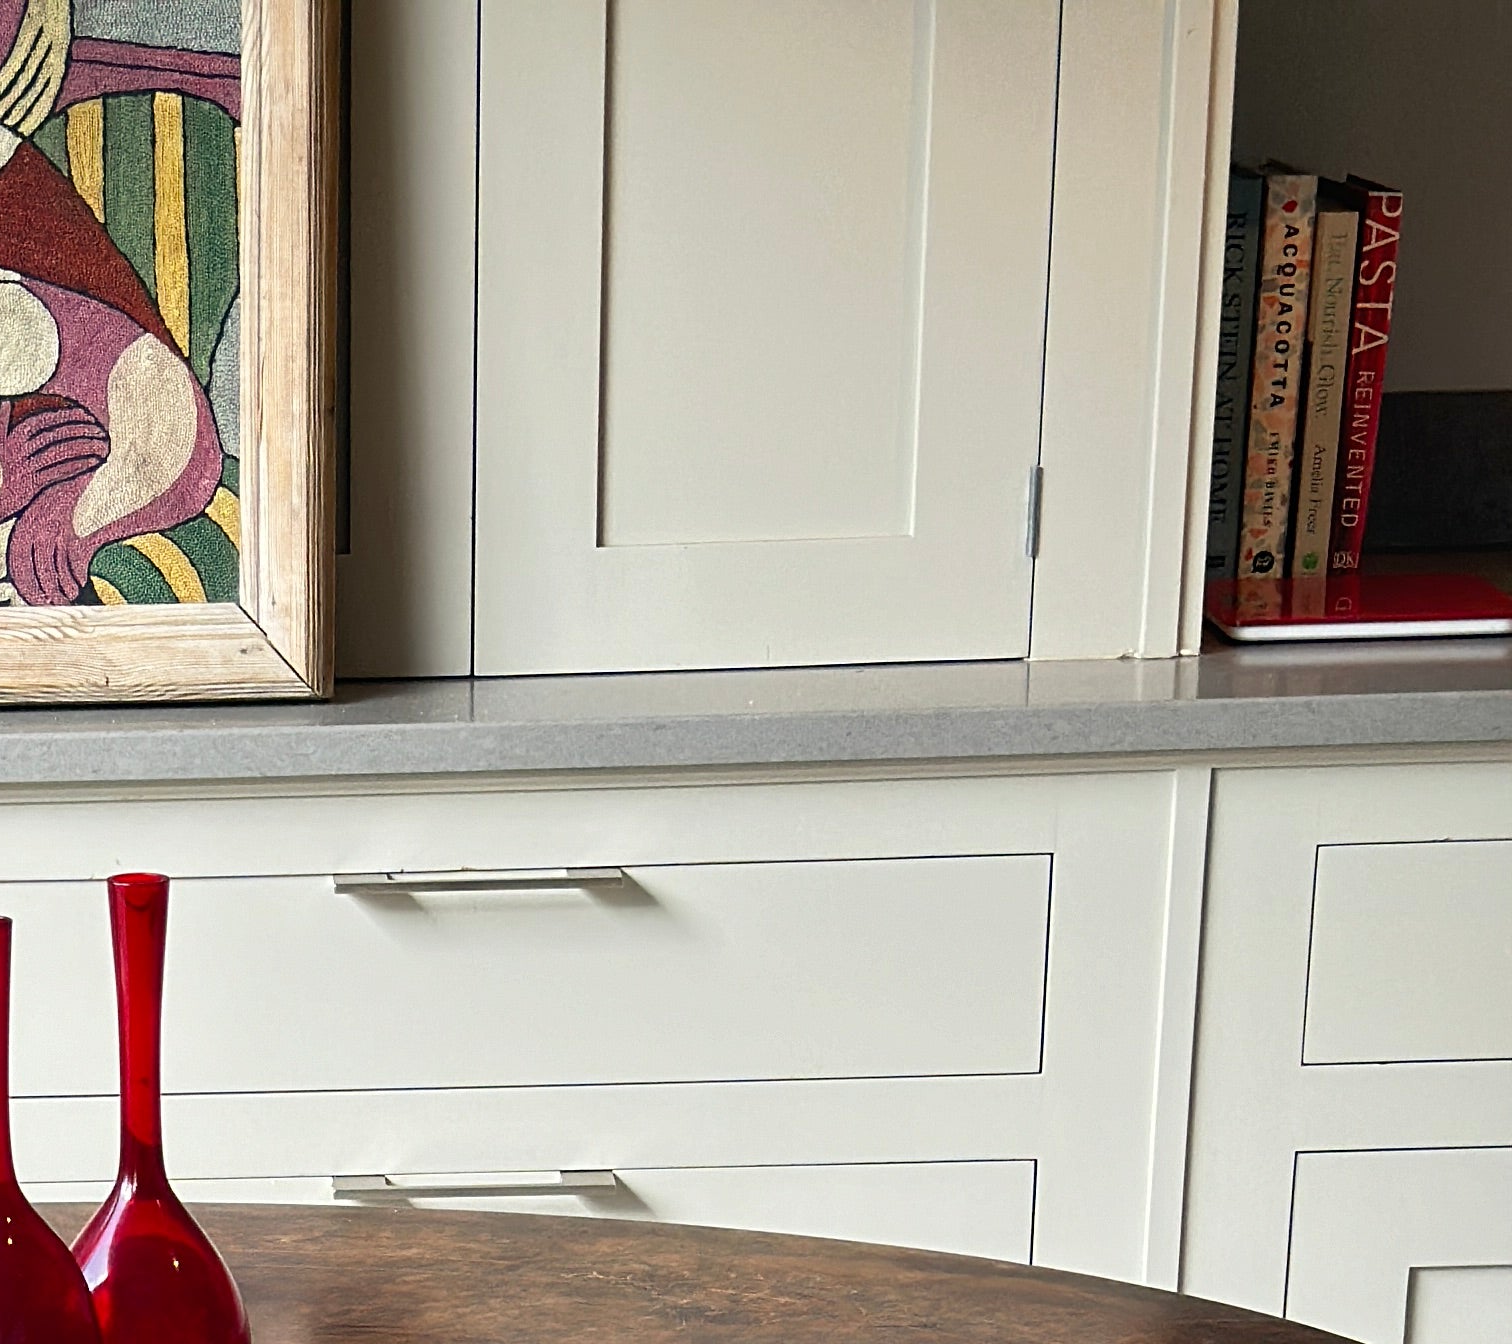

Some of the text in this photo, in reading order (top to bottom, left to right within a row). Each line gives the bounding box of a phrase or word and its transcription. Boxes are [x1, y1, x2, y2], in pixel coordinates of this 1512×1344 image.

[1209, 212, 1248, 524] RICK STEIN AT HOME
[1270, 224, 1300, 408] ACQUACOTTA
[1340, 191, 1403, 528] PASTA REINVENTED
[1306, 444, 1327, 535] Amelia Freer
[1333, 551, 1357, 569] DK
